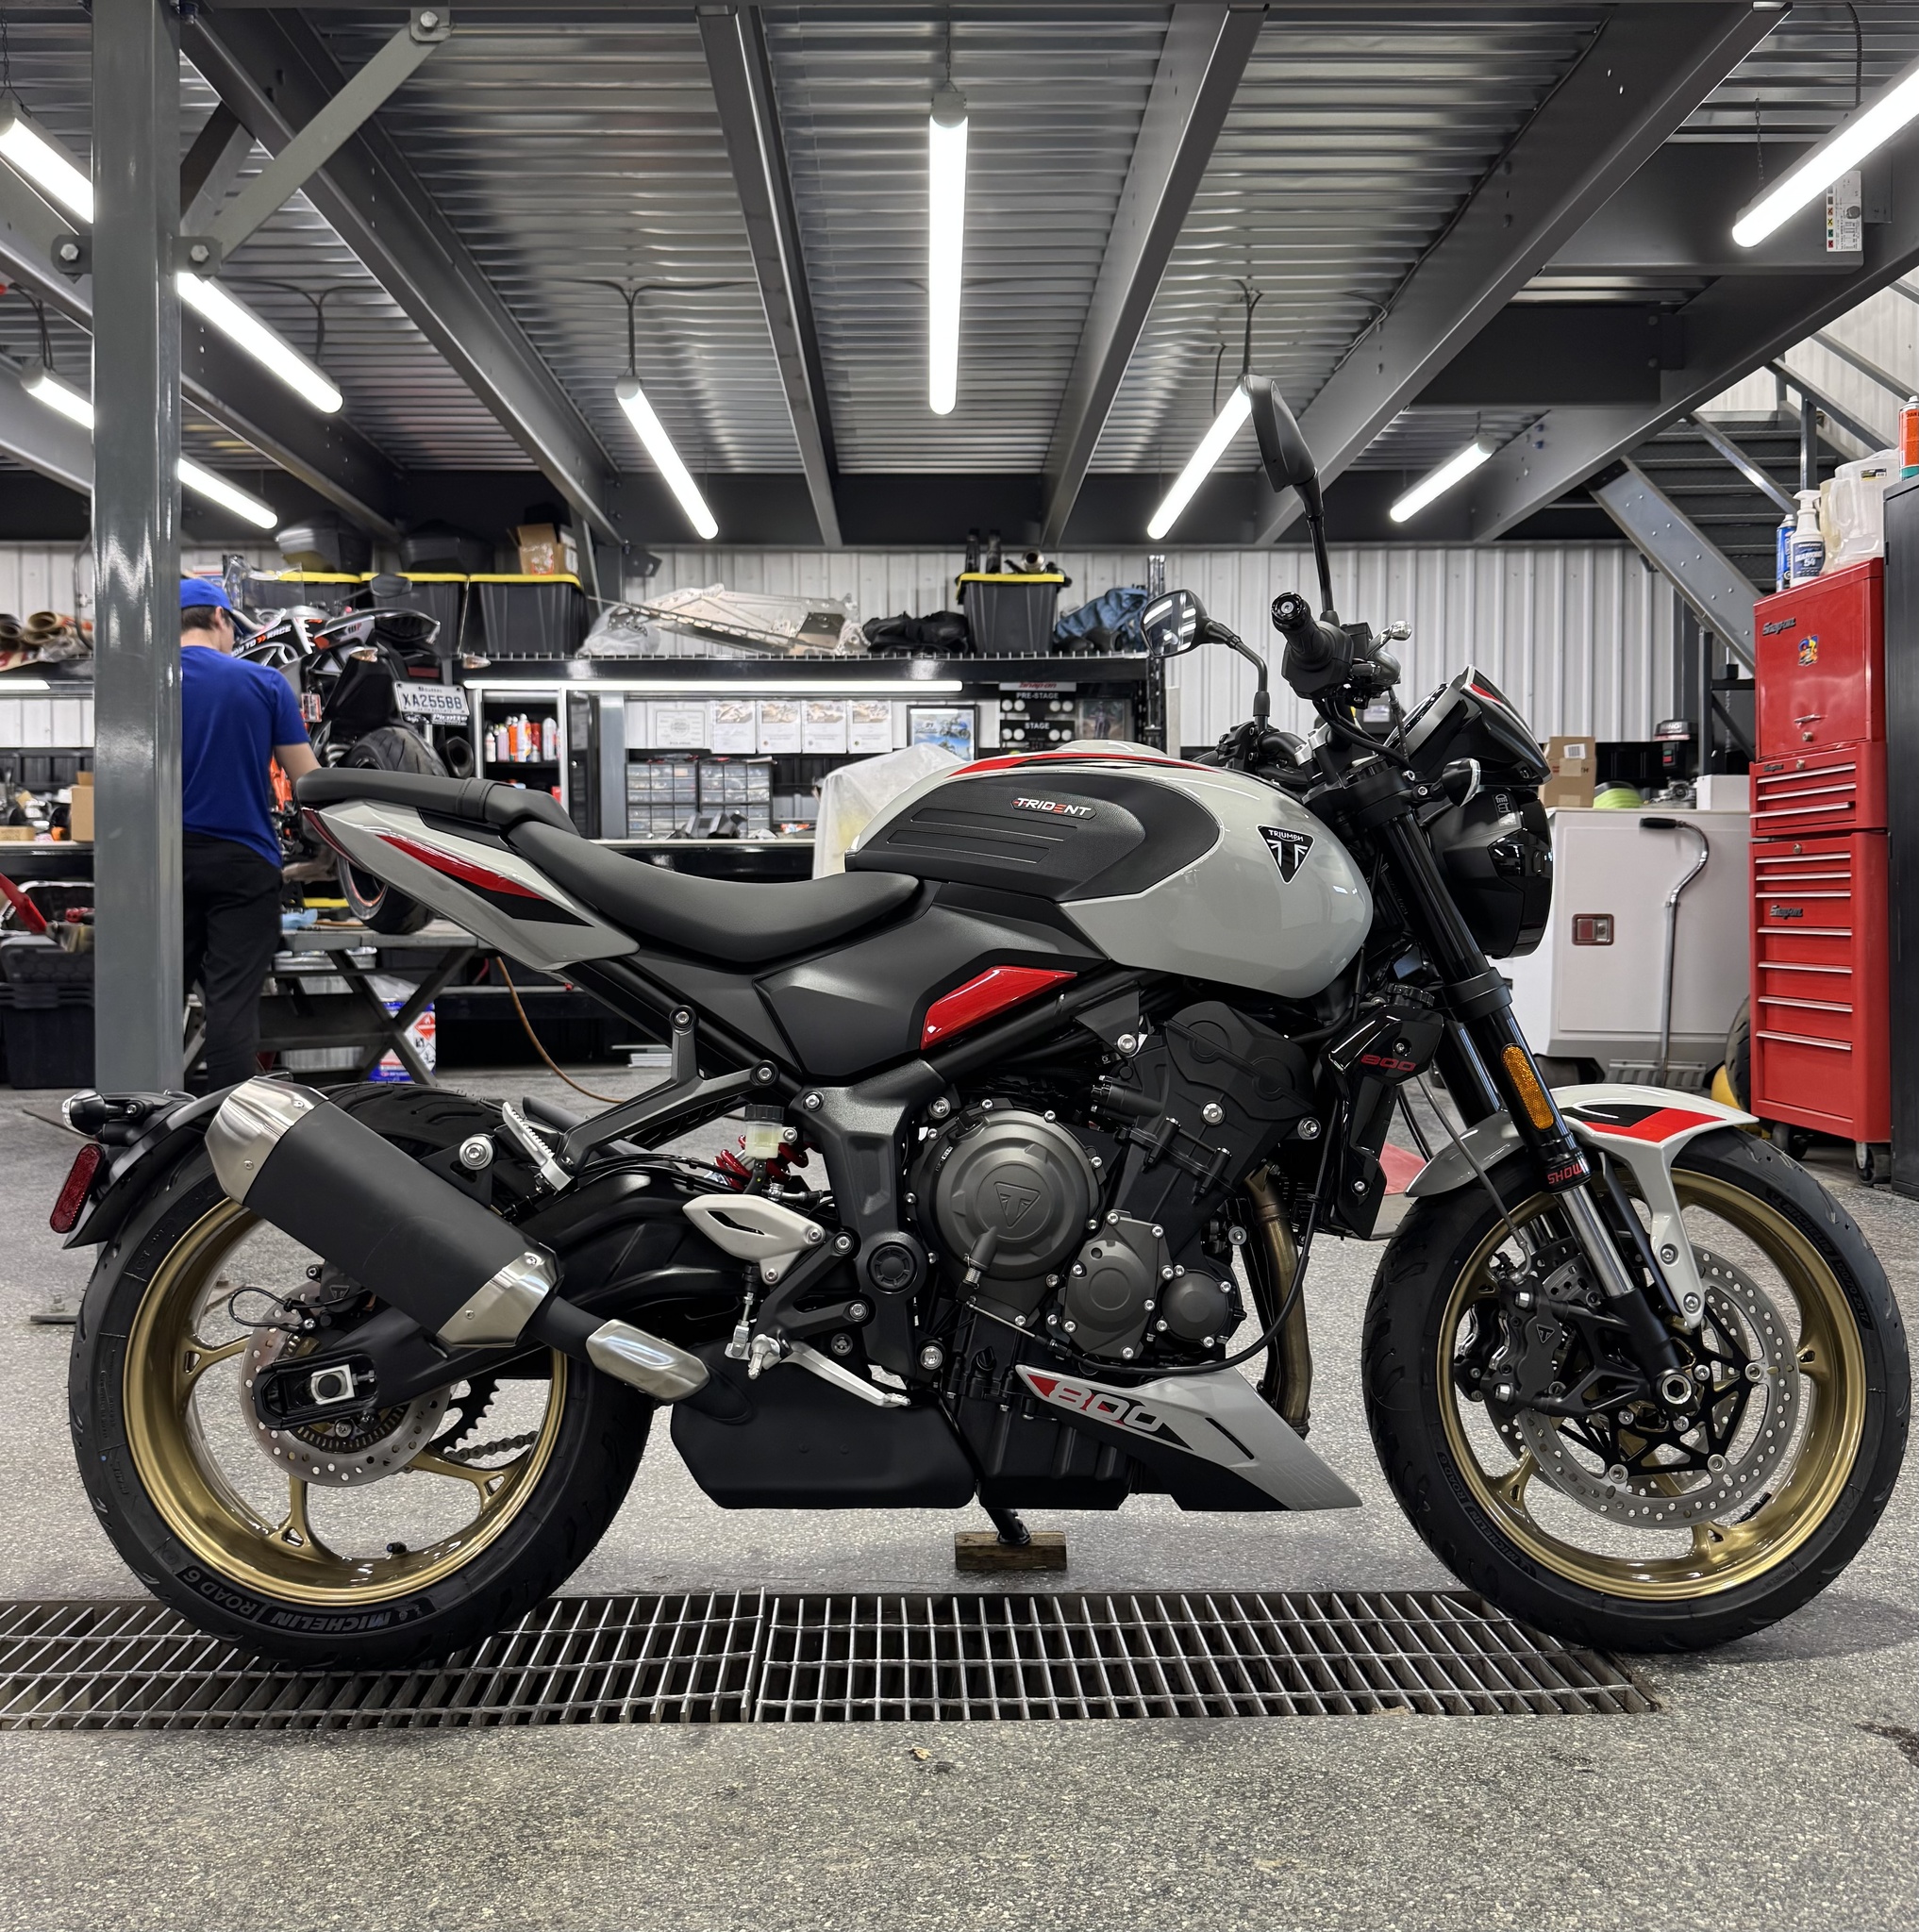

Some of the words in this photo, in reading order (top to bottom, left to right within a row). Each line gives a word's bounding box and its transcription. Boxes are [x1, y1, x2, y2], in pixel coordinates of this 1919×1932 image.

[266, 624, 292, 639] RACE
[1016, 797, 1092, 816] TRIDENT
[1268, 829, 1304, 842] TRIUMPH
[1360, 1054, 1416, 1072] 800
[1547, 1162, 1586, 1185] SHOW
[1048, 1380, 1165, 1432] 800
[1444, 1466, 1467, 1501] ROAD
[1469, 1509, 1520, 1562] MICHELIN
[183, 1569, 201, 1583] 6
[200, 1581, 259, 1616] ROAD
[270, 1611, 392, 1631] MICHELIN
